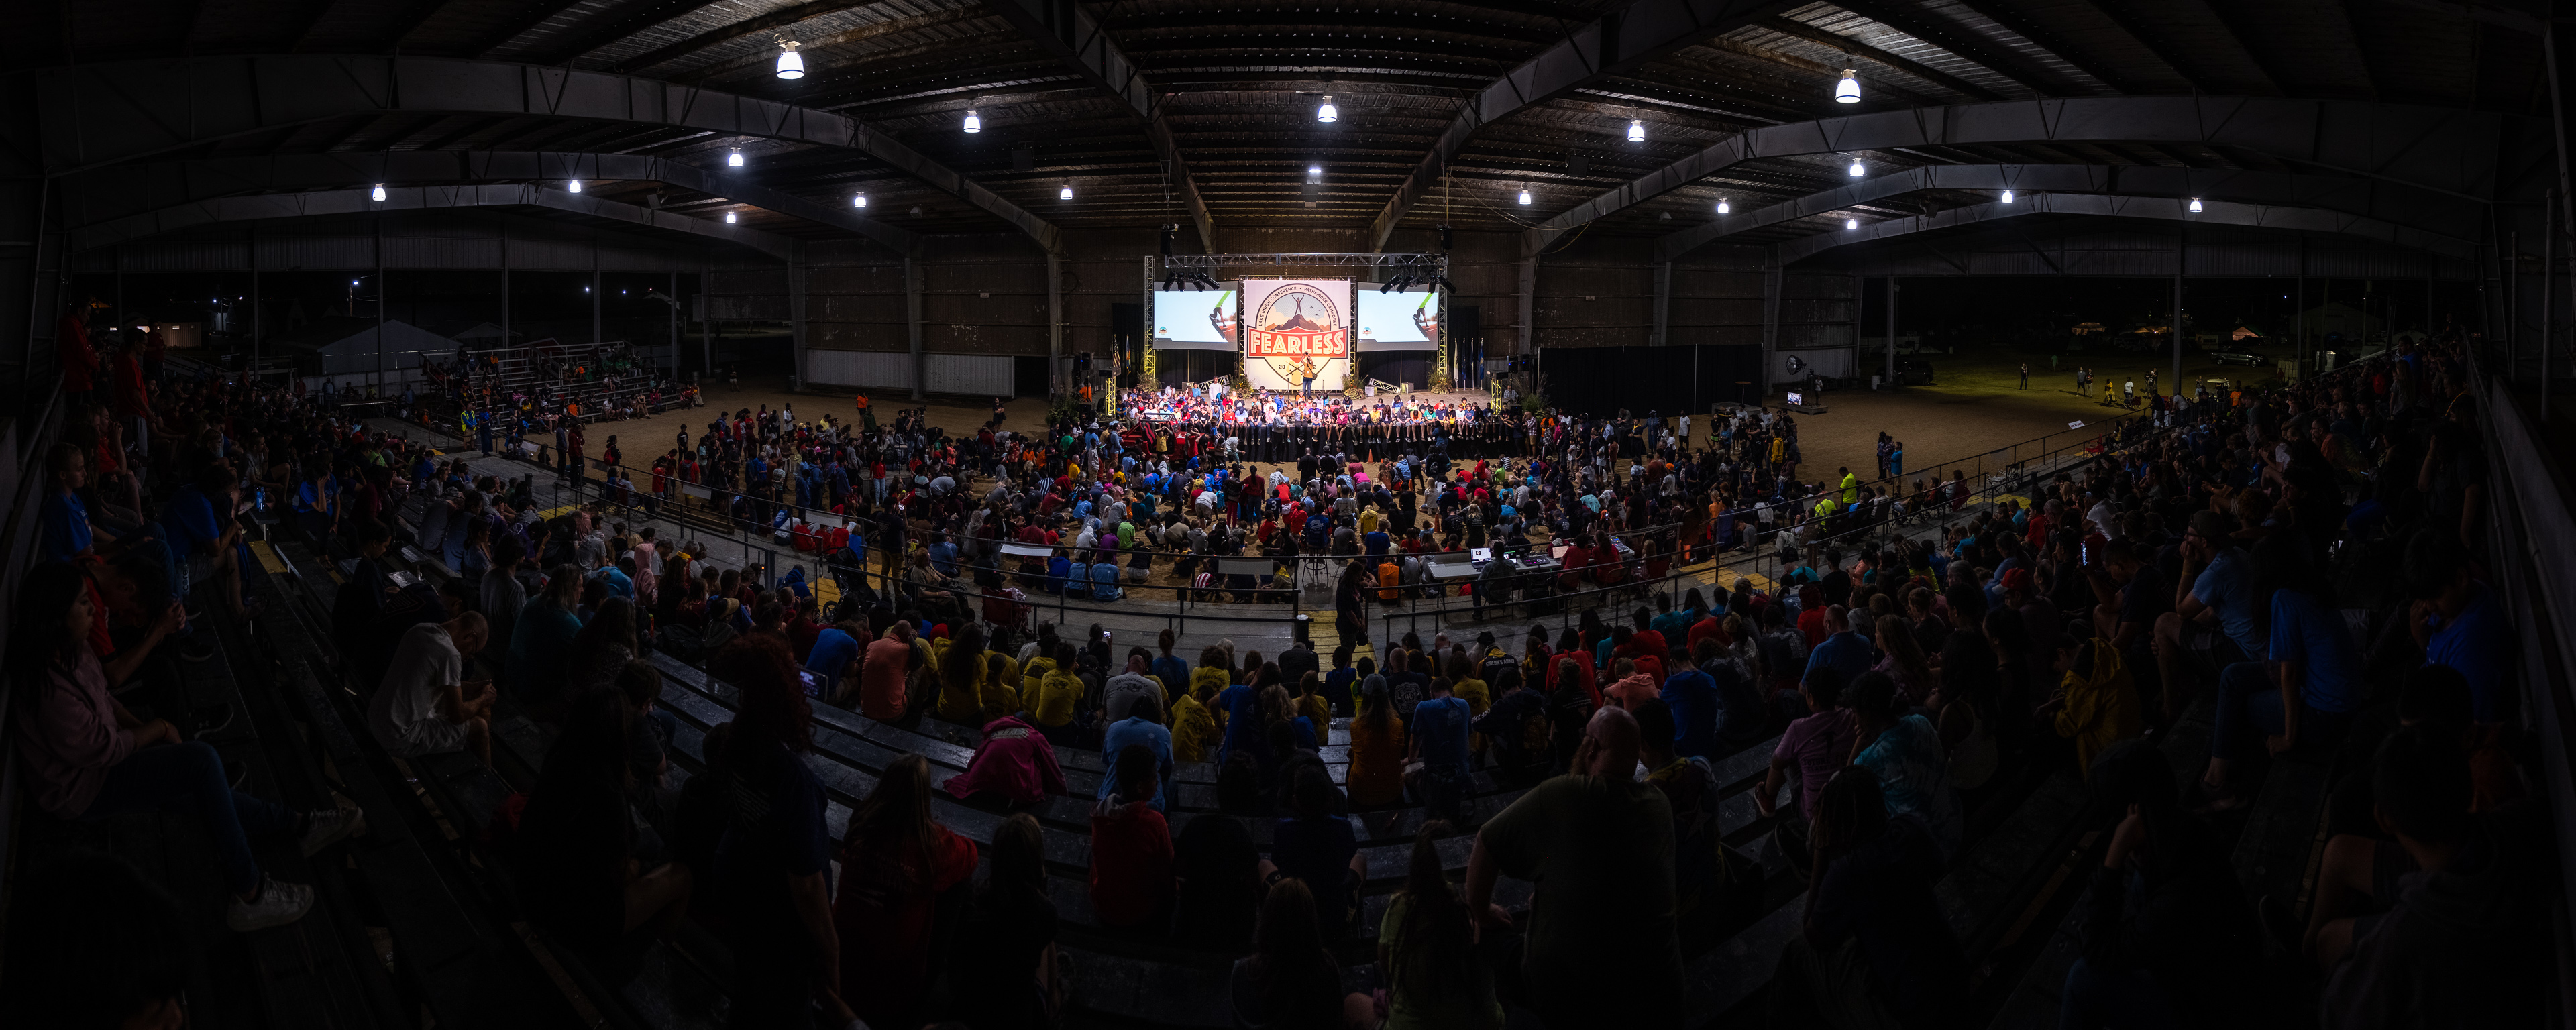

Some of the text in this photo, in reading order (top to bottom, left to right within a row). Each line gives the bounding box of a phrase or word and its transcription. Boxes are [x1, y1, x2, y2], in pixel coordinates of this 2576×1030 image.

[1261, 300, 1271, 314] UNION
[1270, 287, 1297, 301] CONFERENCE
[1303, 287, 1328, 304] PATHFINDER
[1326, 303, 1338, 327] CAMPOREE
[1250, 331, 1344, 355] FEARLESS
[1271, 500, 1277, 510] 3
[1485, 659, 1503, 667] GIDEON'S
[1114, 676, 1148, 688] Wolverines
